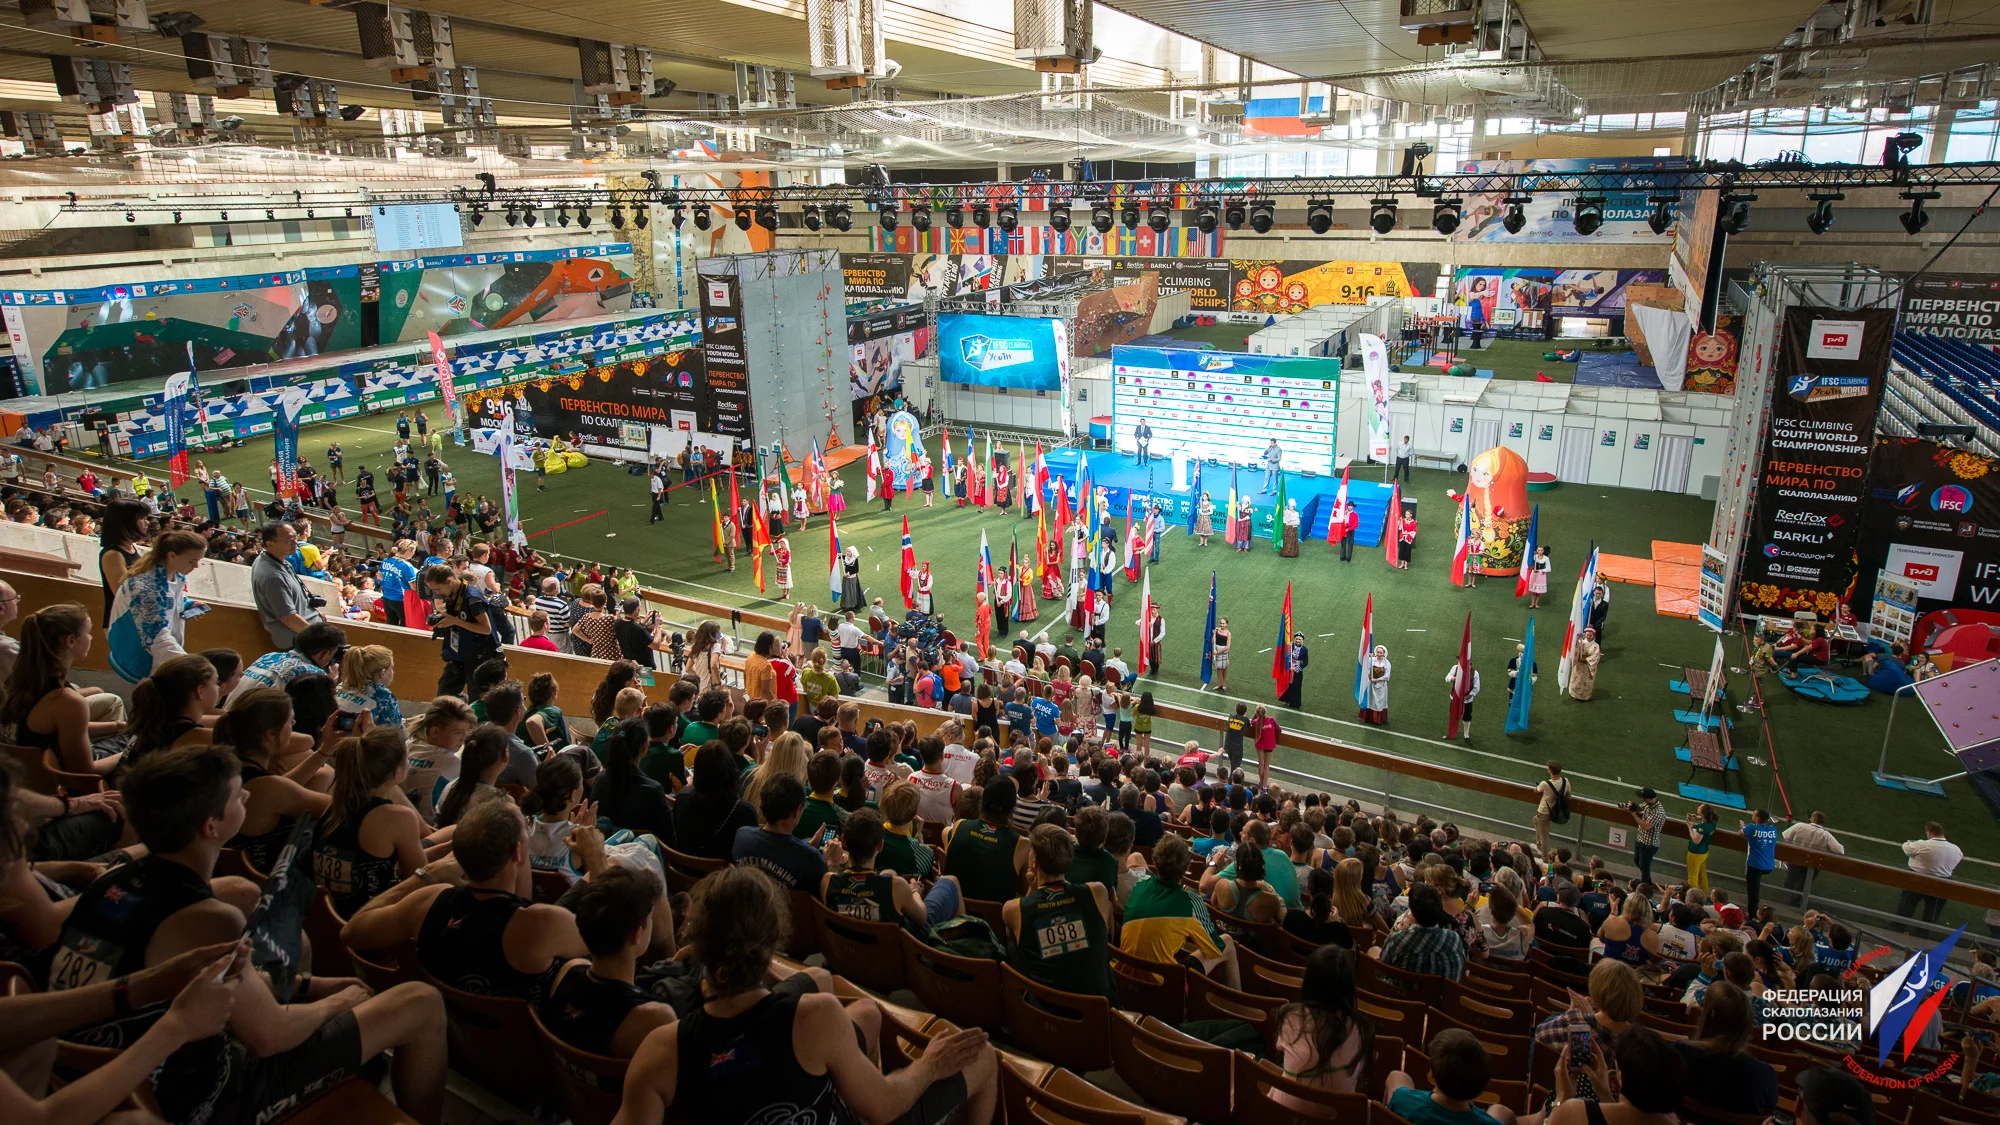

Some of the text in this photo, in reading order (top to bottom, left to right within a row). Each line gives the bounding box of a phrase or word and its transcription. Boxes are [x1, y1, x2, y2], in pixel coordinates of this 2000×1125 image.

[1552, 210, 1568, 218] ПО
[1164, 277, 1210, 287] CLIMBING
[1906, 312, 1992, 326] МИРА ПО
[708, 370, 745, 380] ПЕРВЕНСТВО
[1821, 378, 1839, 386] IFSC
[1841, 386, 1866, 394] WORLD
[560, 398, 667, 420] ПЕРВЕНСТВО МИРА
[581, 415, 594, 424] ПО
[1775, 418, 1853, 431] IFSC CLIMBING
[1774, 429, 1858, 442] YOUTH WORLD
[1772, 440, 1868, 454] CHAMPIONSHIPS
[1768, 461, 1862, 478] ПЕРВЕНСТВО
[1766, 475, 1836, 490] МИРА ПО
[1778, 490, 1858, 502] СКАЛОЛАЗАНИЮ
[1940, 500, 1962, 510] IFSC
[1776, 510, 1827, 523] RedFox
[1773, 531, 1823, 543] BARKLI
[917, 779, 949, 788] KYRGYZ
[970, 831, 983, 839] SOUTH
[1614, 833, 1621, 843] 3
[1753, 830, 1776, 838] JUDGE
[317, 854, 342, 880] 338
[760, 858, 798, 888] MACHINA
[1057, 898, 1075, 906] AFRICA
[1046, 923, 1077, 944] 098
[1621, 952, 1640, 962] GBR
[56, 951, 97, 989] 282
